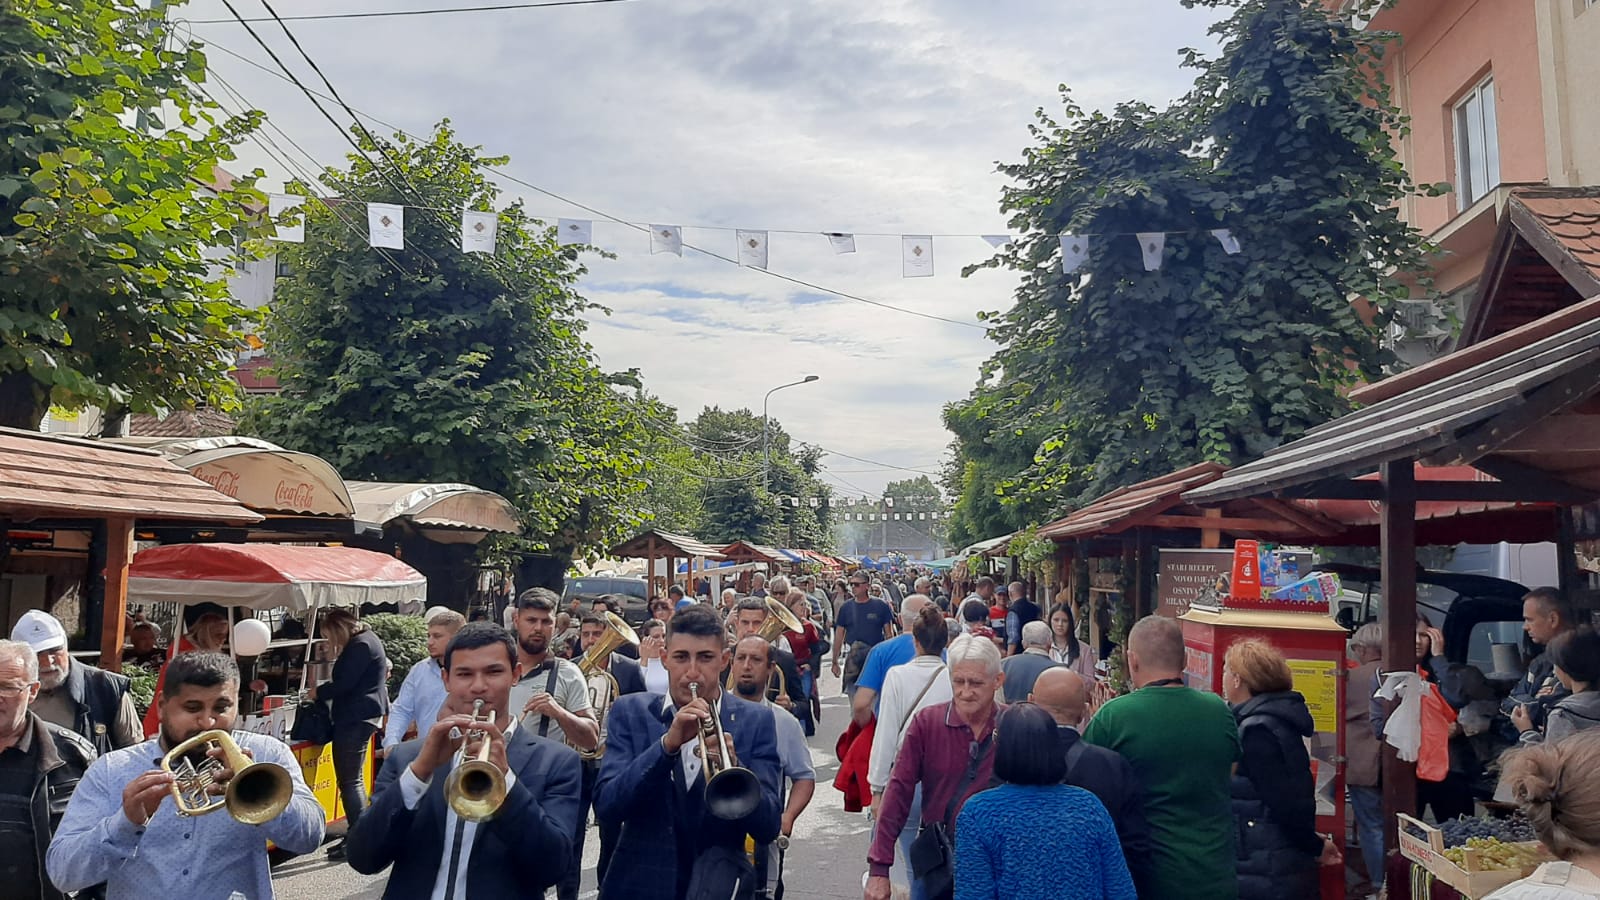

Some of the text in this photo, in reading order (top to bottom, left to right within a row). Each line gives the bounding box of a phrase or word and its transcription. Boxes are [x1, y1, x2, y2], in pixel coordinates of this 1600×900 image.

[1167, 563, 1187, 571] STARI
[1173, 575, 1193, 583] NOVO
[1172, 587, 1200, 595] OSNIVA
